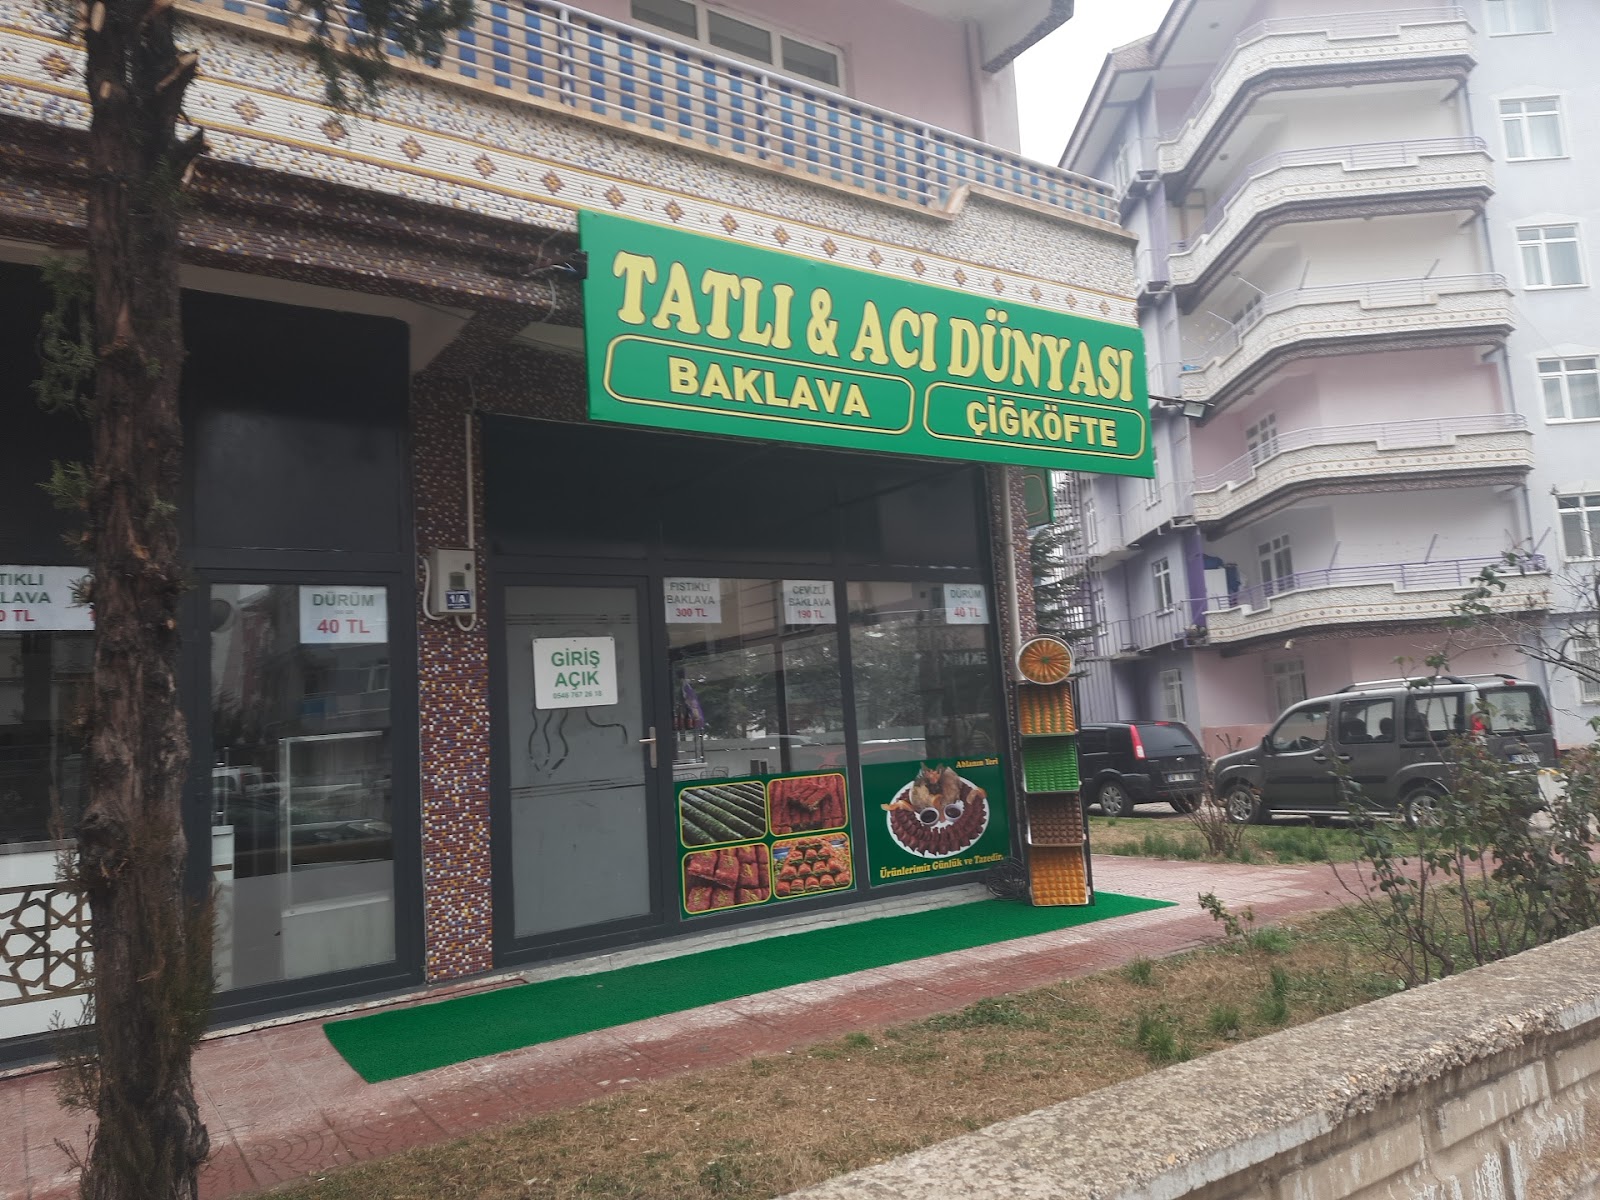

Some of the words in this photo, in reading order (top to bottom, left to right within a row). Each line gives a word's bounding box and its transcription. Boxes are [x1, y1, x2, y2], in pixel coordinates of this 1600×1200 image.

[612, 250, 795, 350] TATLI
[806, 287, 840, 358] &
[850, 299, 939, 373] ACI
[947, 307, 1134, 403] DÜNYASI
[668, 355, 871, 418] BAKLAVA
[966, 396, 1119, 448] ÇİĞKÖFTE
[312, 591, 375, 607] DÜRÜM
[667, 595, 716, 605] BAKLAVA
[950, 588, 981, 599] DÜRÜM
[789, 598, 831, 607] BAKLAVA
[12, 610, 35, 622] TL
[676, 608, 693, 618] 300
[695, 608, 708, 618] TL
[814, 609, 825, 619] TL
[954, 607, 966, 618] 40
[968, 607, 981, 618] TL
[317, 619, 340, 634] 40
[345, 619, 371, 634] TL
[551, 648, 600, 668] GİRİŞ
[555, 671, 599, 690] AÇIK
[879, 863, 931, 879] Ürünlerimiz
[932, 858, 963, 870] Günlük
